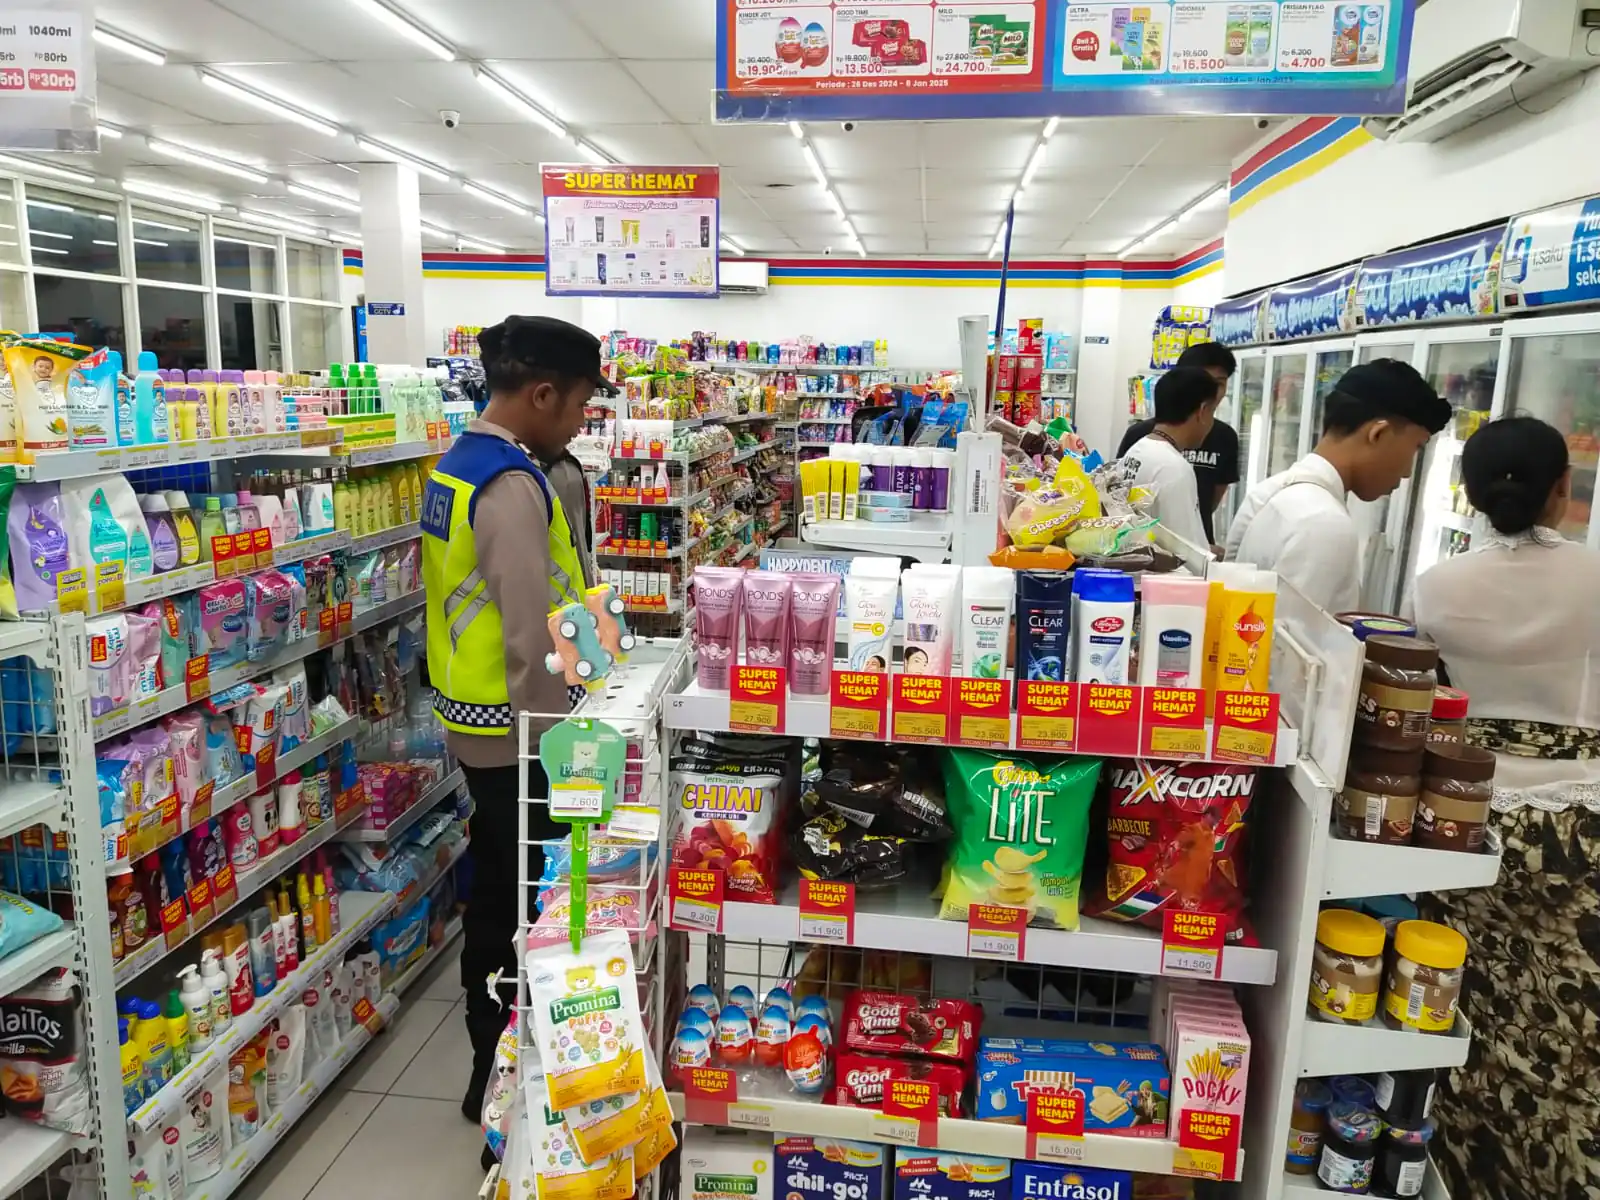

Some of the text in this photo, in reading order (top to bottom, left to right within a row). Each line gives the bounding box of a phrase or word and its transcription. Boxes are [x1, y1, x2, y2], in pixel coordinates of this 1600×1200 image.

[29, 25, 71, 37] 1040ml
[845, 63, 882, 74] 13.500
[945, 62, 985, 73] 24.700
[1183, 58, 1225, 70] 16.500
[1291, 57, 1325, 68] 4.700
[816, 80, 845, 88] Periode
[879, 80, 898, 88] 2024
[564, 173, 697, 189] SUPER HEMAT
[767, 558, 832, 573] HAPPYDENT
[699, 587, 734, 599] POND'S
[748, 590, 784, 601] POND'S
[793, 592, 829, 602] POND'S
[909, 599, 931, 609] Glow
[864, 610, 887, 618] Lovely
[916, 610, 942, 618] Lovely
[971, 614, 1004, 625] CLEAR
[1028, 615, 1064, 628] CLEAR
[1233, 619, 1267, 632] sunsilk
[1162, 634, 1190, 643] Vaseline
[738, 669, 777, 680] SUPER
[839, 673, 879, 685] SUPER
[738, 680, 778, 690] HEMAT
[901, 677, 942, 689] SUPER
[960, 680, 1002, 692] SUPER
[839, 684, 879, 696] HEMAT
[901, 688, 942, 700] HEMAT
[1027, 684, 1069, 696] SUPER
[1089, 687, 1132, 699] SUPER
[960, 691, 1002, 703] HEMAT
[1027, 694, 1069, 707] HEMAT
[1153, 690, 1196, 703] SUPER
[1225, 694, 1270, 708] SUPER
[1089, 698, 1132, 711] HEMAT
[1152, 701, 1196, 714] HEMAT
[1224, 705, 1269, 718] HEMAT
[744, 716, 771, 724] 27.900
[846, 721, 874, 731] 25.500
[911, 726, 941, 735] 25.500
[974, 730, 1005, 740] 23.900
[1036, 730, 1068, 739] 23.900
[570, 797, 598, 806] 7.600
[681, 784, 763, 813] CHIMI
[678, 871, 715, 881] SUPER
[677, 881, 716, 892] HEMAT
[808, 882, 847, 894] SUPER
[808, 892, 847, 904] HEMAT
[690, 911, 716, 923] 9.300
[978, 906, 1018, 917] SUPER
[977, 913, 1018, 923] HEMAT
[1174, 914, 1217, 926] SUPER
[811, 925, 844, 936] 11.900
[1173, 924, 1216, 936] HEMAT
[982, 941, 1016, 951] 11.900
[1177, 958, 1212, 970] 11.500
[551, 993, 618, 1020] Promina
[858, 1002, 900, 1017] Good
[861, 1015, 900, 1031] Time
[692, 1069, 728, 1081] SUPER
[846, 1068, 892, 1086] Good
[692, 1078, 729, 1089] HEMAT
[892, 1082, 930, 1094] SUPER
[1181, 1076, 1242, 1107] POCKY
[892, 1092, 930, 1104] HEMAT
[1036, 1096, 1076, 1109] SUPER
[1036, 1107, 1076, 1119] HEMAT
[1190, 1112, 1232, 1125] SUPER
[1189, 1123, 1231, 1136] HEMAT
[1050, 1145, 1082, 1156] 15.000
[698, 1176, 754, 1193] Promina
[1024, 1174, 1121, 1200] Entrasol
